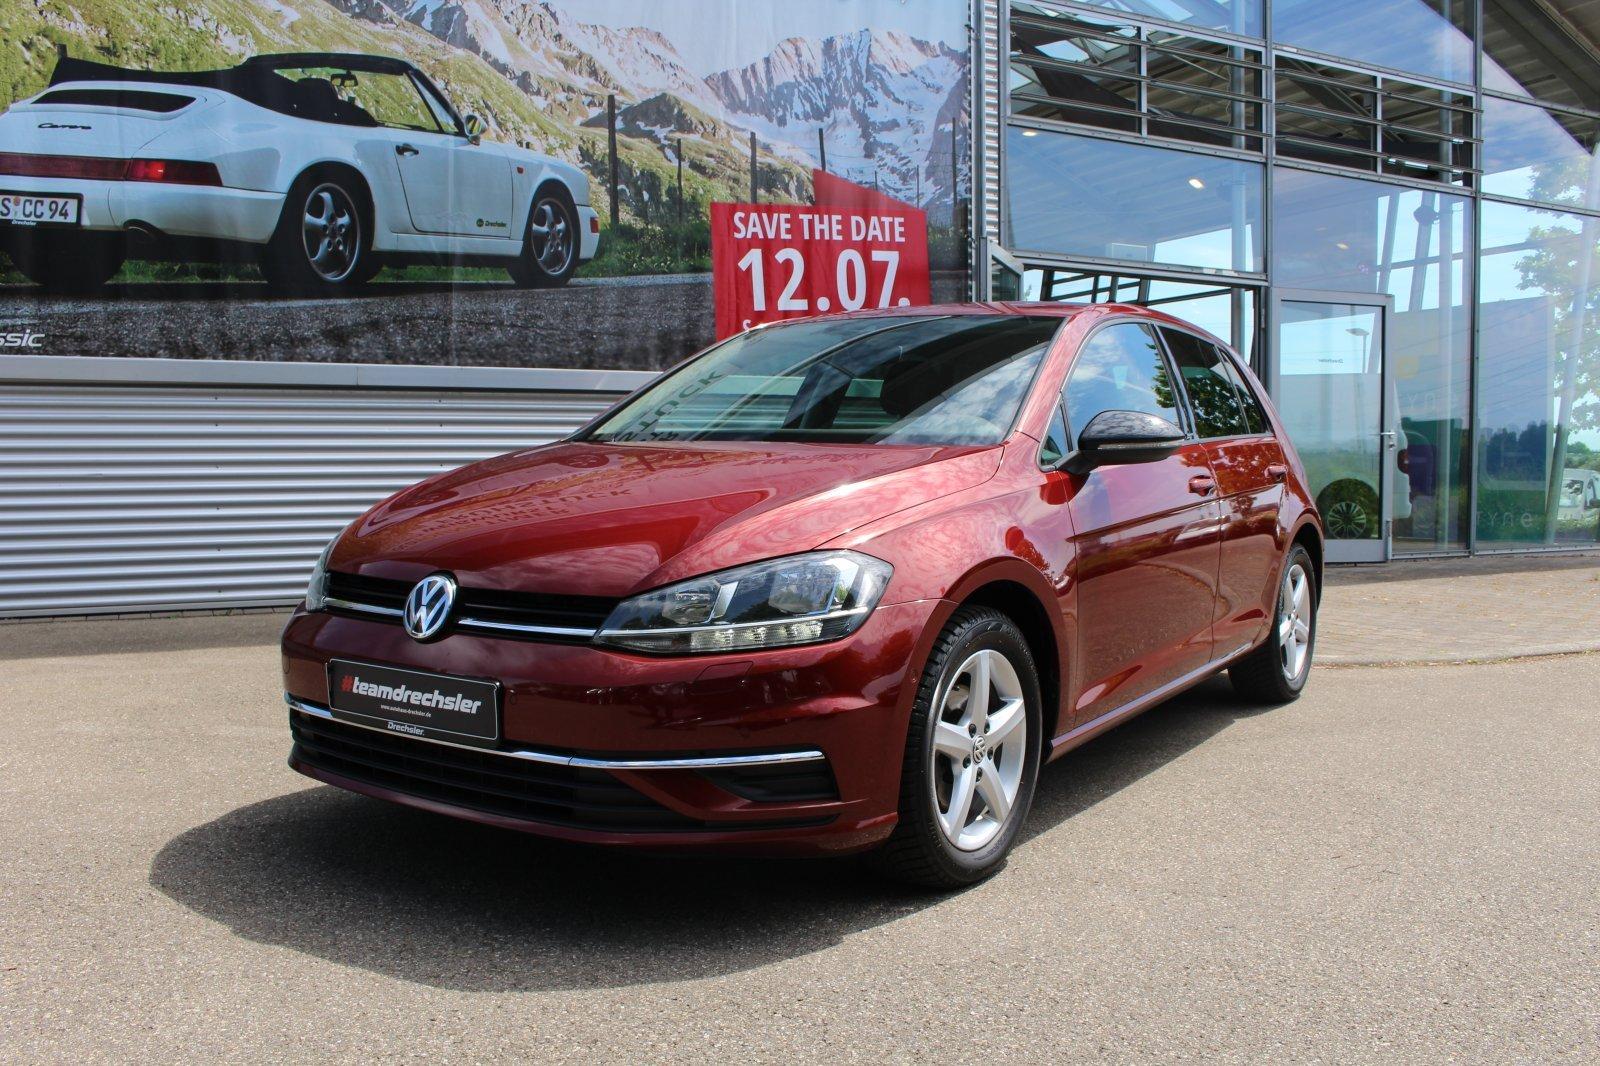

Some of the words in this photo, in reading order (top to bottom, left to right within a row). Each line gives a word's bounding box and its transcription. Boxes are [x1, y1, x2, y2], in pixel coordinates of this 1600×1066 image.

[49, 200, 69, 220] 94
[733, 211, 792, 240] SAVE
[798, 213, 843, 241] THE
[851, 215, 906, 243] DATE
[737, 247, 911, 312] 12.07.
[340, 675, 482, 714] #teamdrechsler
